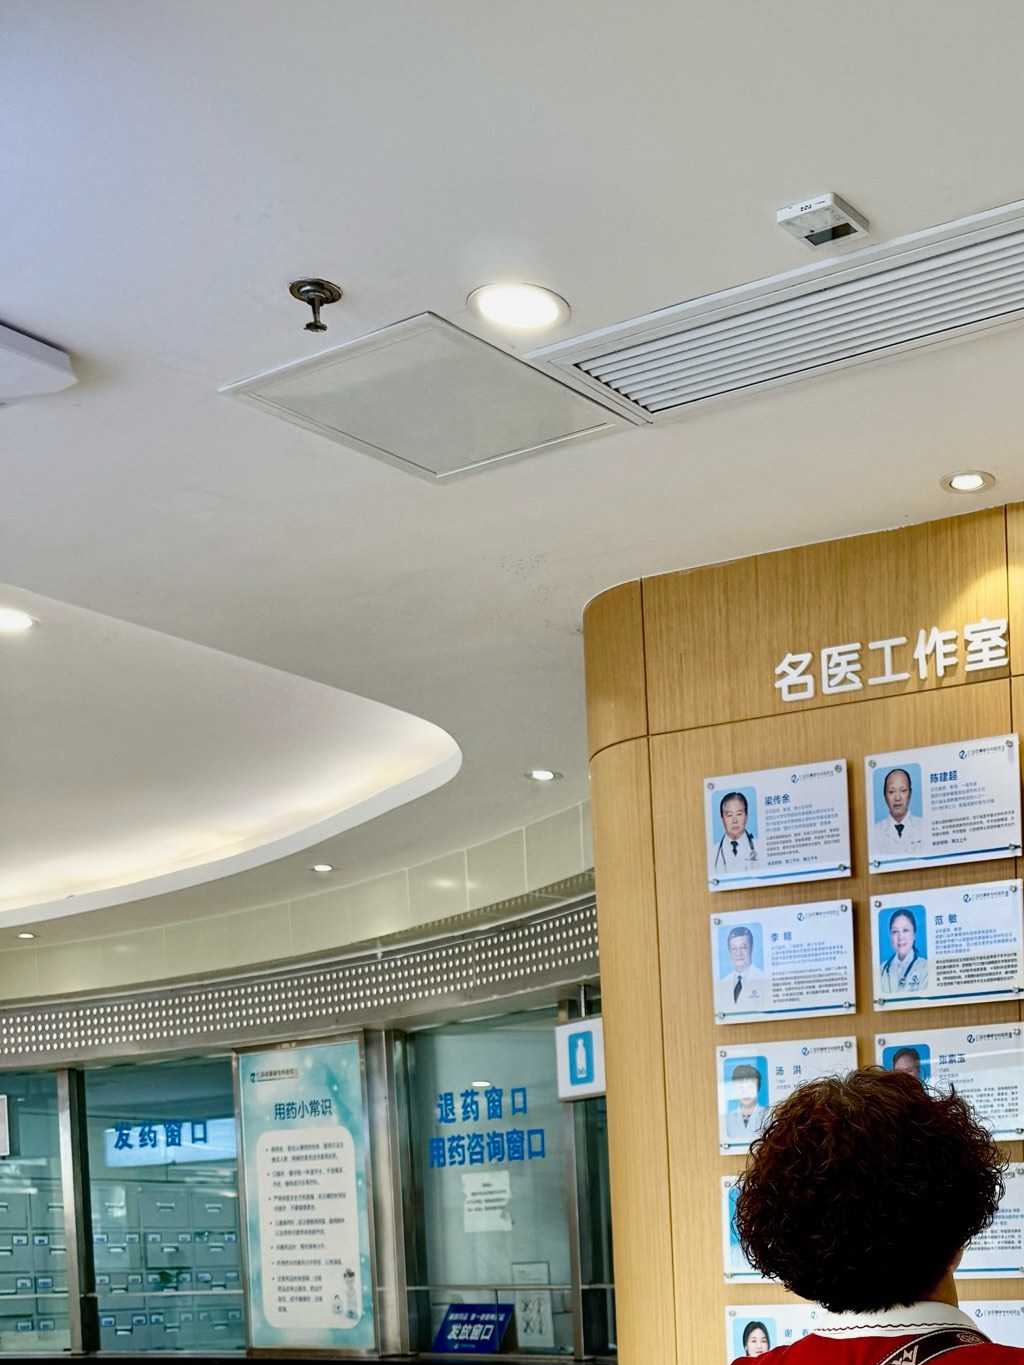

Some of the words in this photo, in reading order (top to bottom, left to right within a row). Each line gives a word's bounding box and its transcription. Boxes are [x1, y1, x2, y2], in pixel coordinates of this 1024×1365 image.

[274, 1098, 332, 1121] 用药小常识
[437, 1087, 528, 1124] 退药窗口
[113, 1119, 208, 1151] 发药窗口
[428, 1128, 546, 1169] 用药咨询窗口
[447, 1323, 495, 1341] 发放窗口
